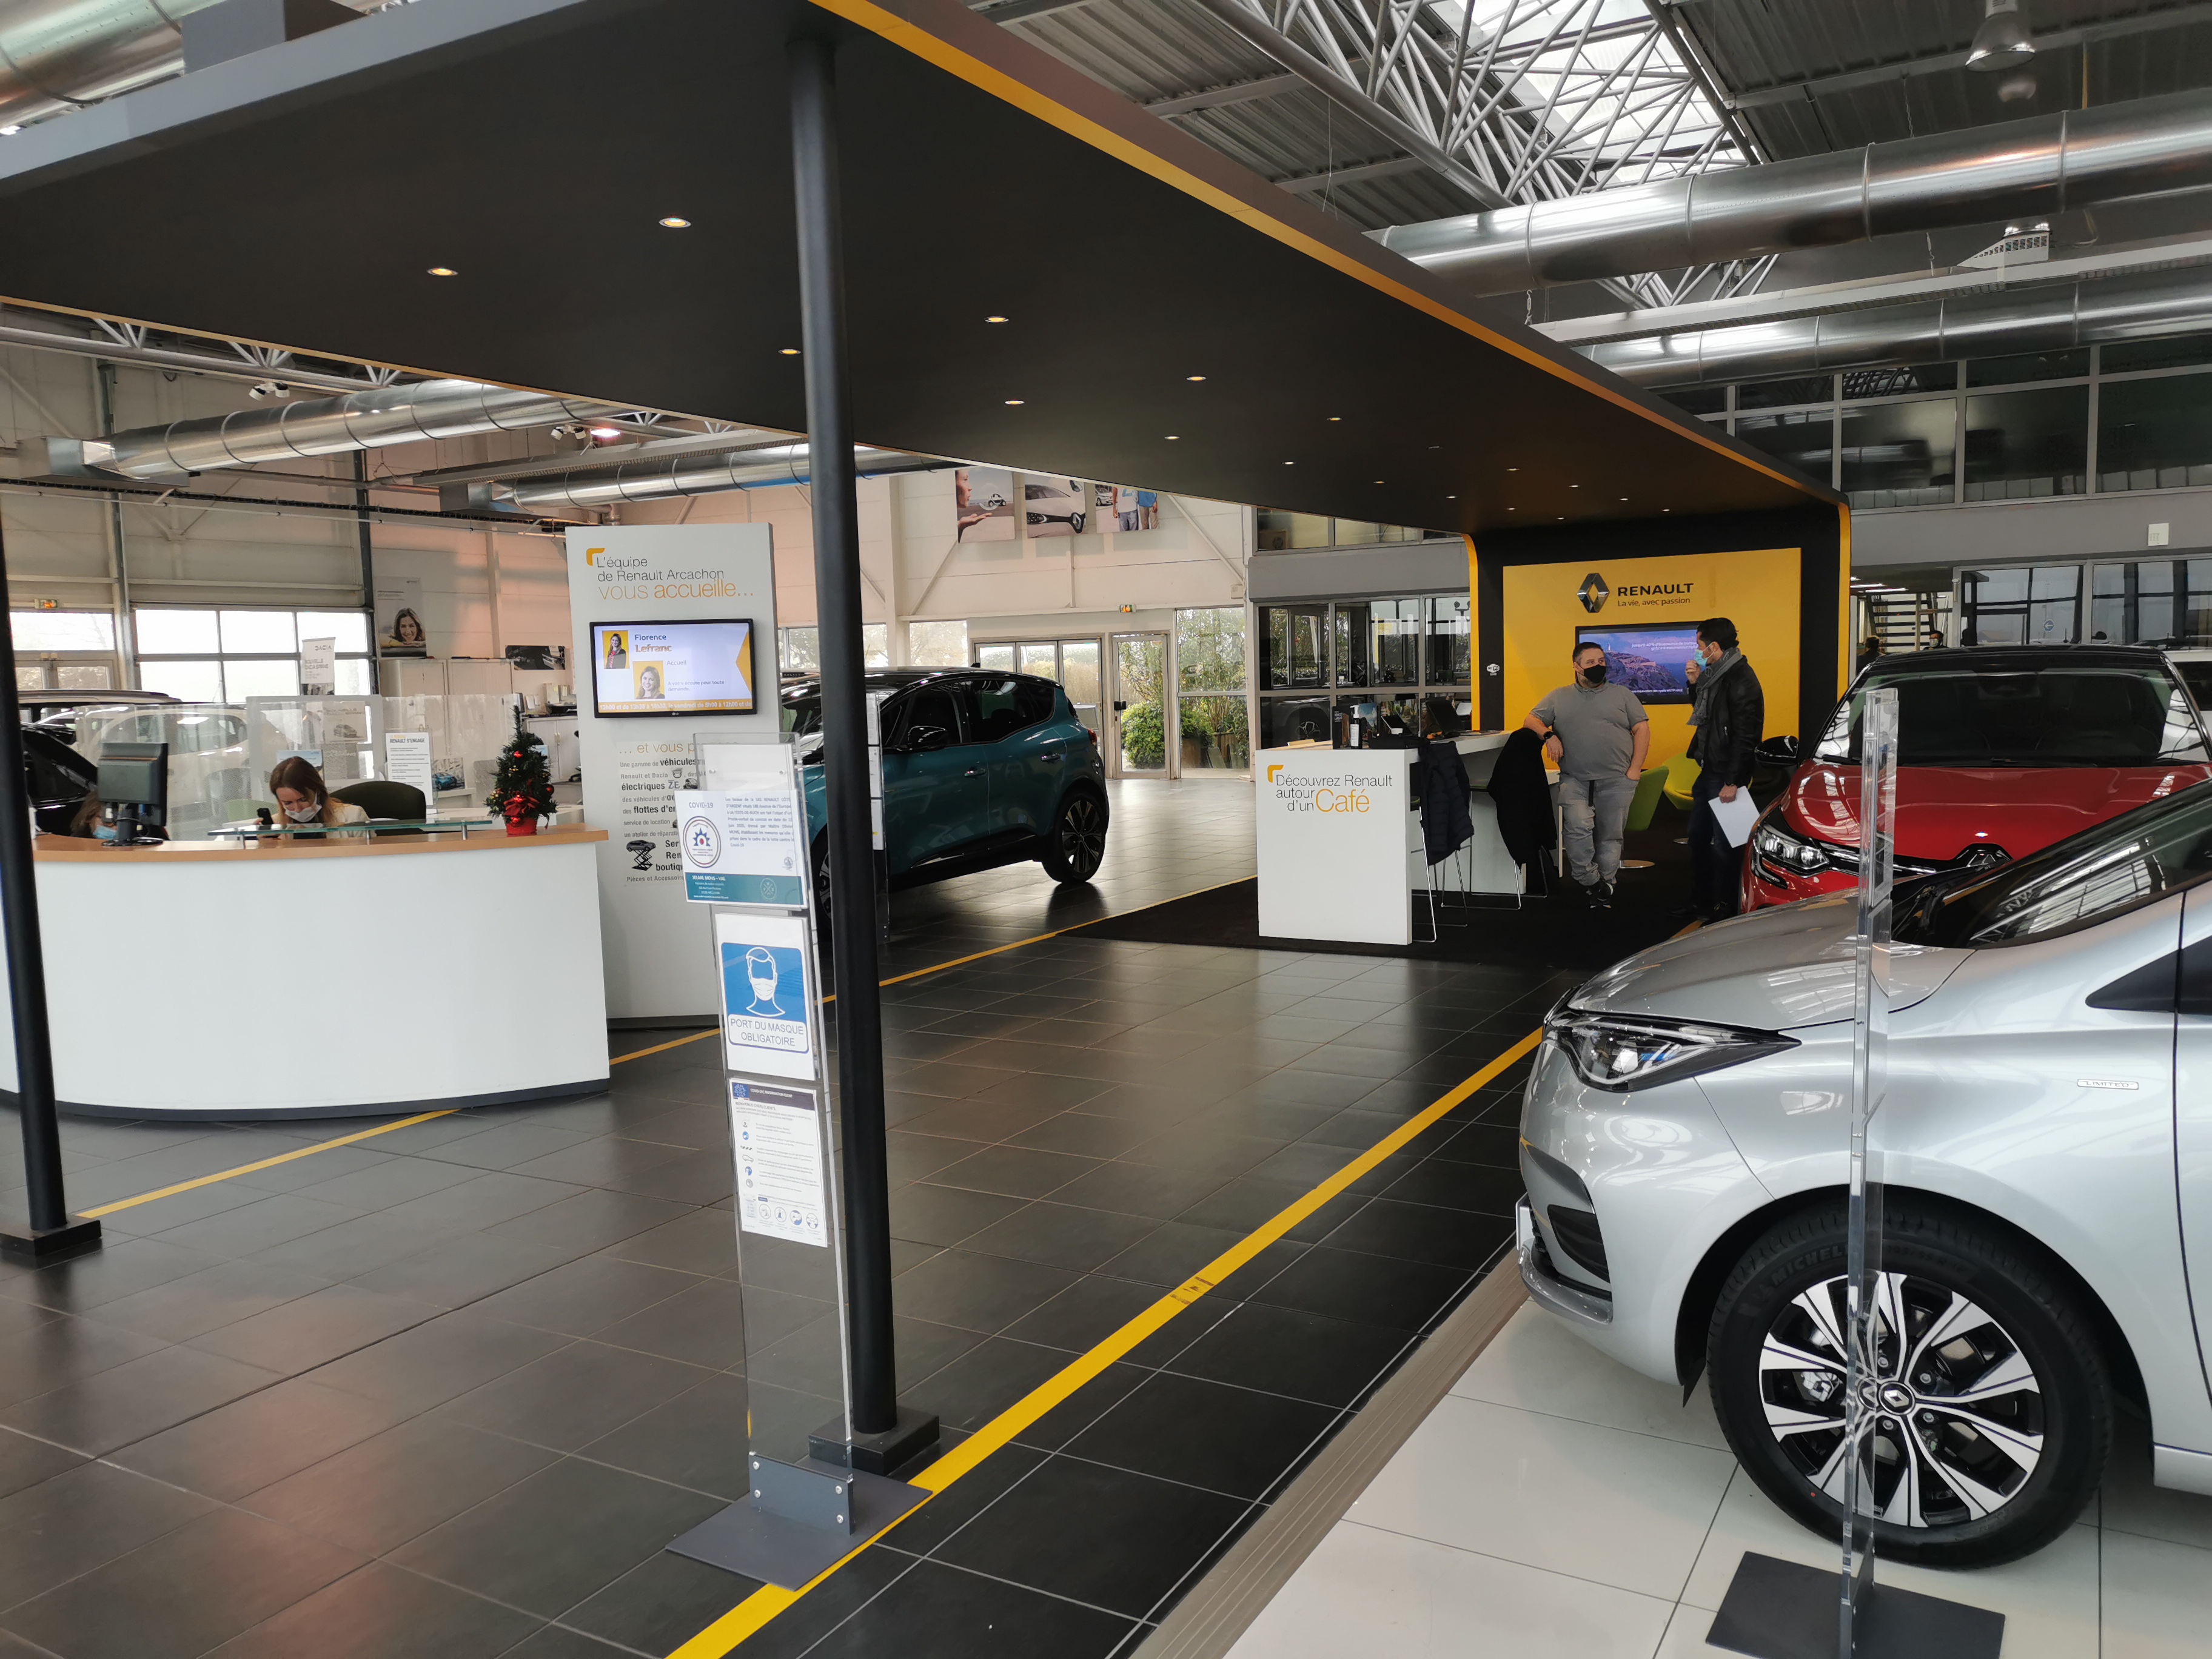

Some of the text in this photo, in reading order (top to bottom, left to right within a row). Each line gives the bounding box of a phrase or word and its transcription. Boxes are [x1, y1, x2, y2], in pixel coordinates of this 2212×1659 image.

[597, 556, 648, 569] L'équipe
[597, 568, 724, 582] de Renault Arcachon
[598, 585, 648, 600] vous
[1617, 583, 1694, 597] RENAULT
[1661, 597, 1691, 606] passion
[635, 644, 672, 652] Lefranc
[637, 743, 649, 754] et
[653, 743, 683, 753] vous
[1276, 774, 1393, 786] Découvrez Renault
[622, 782, 665, 791] électriques
[1276, 788, 1315, 799] autour
[1287, 788, 1370, 813] d'un Café
[634, 805, 659, 814] flottes
[731, 1018, 804, 1035] PORT DU MASQUE
[741, 1031, 796, 1047] OBLIGATOIRE
